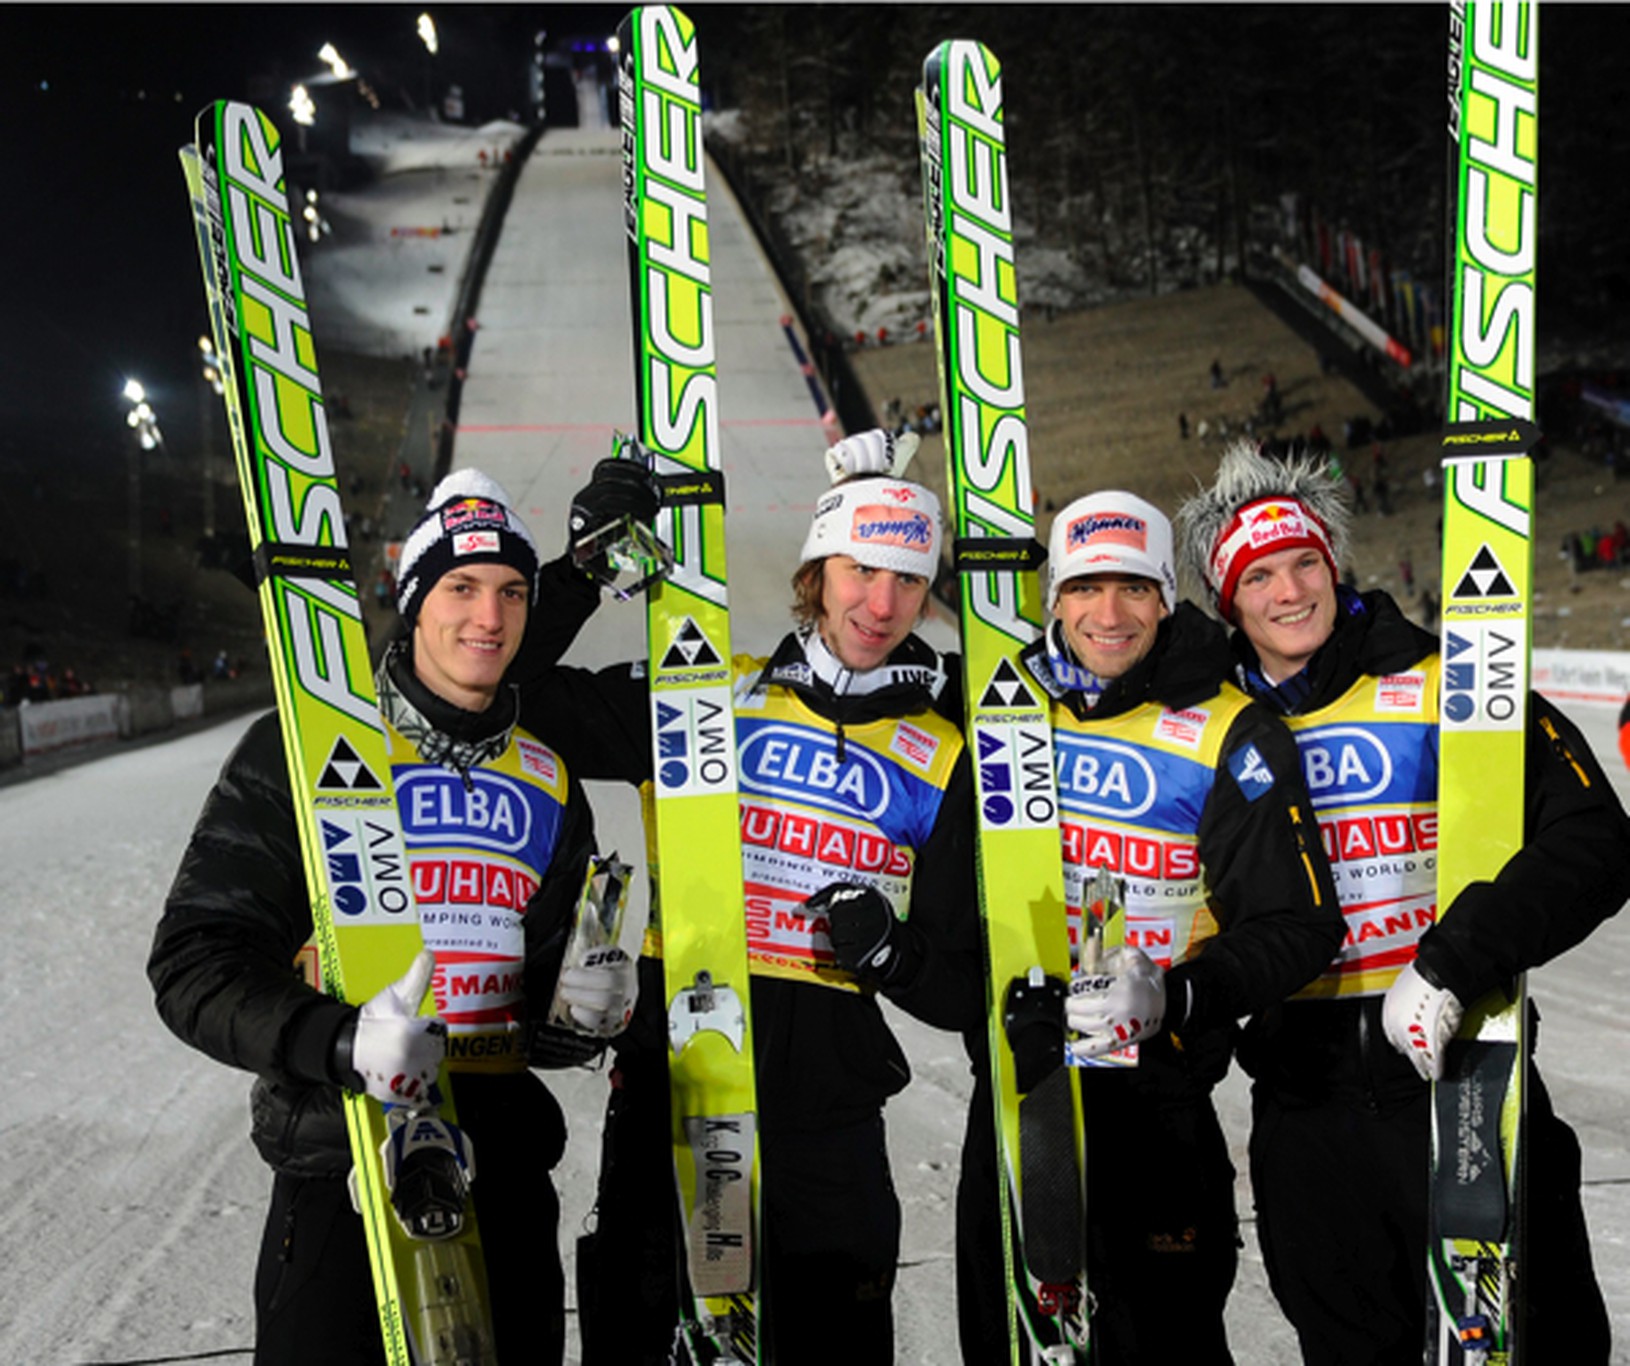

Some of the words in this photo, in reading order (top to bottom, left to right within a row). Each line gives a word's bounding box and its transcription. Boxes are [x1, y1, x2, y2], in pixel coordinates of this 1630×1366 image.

[1454, 3, 1537, 540] FISCHE
[639, 5, 729, 606] FISCHER
[947, 40, 1045, 643] FISCHER
[223, 101, 387, 735] FISCHER
[1251, 524, 1280, 544] Red
[1280, 521, 1304, 536] Bull
[1445, 602, 1523, 614] FISCHER
[654, 671, 728, 685] FISCHER
[1485, 630, 1516, 722] OMV
[696, 699, 728, 785] OMV
[974, 712, 1045, 723] FISCHER
[756, 740, 867, 806] ELBA
[1019, 730, 1054, 823] OMV
[1057, 751, 1132, 804] LBA
[1305, 743, 1372, 789] BA
[313, 796, 392, 807] FISCHER
[411, 784, 516, 837] ELBA
[364, 821, 409, 914] OMV
[746, 811, 909, 873] UHAUS
[1062, 830, 1196, 875] HAUS
[414, 865, 537, 908] UHAU
[1348, 860, 1417, 880] WORLD
[423, 911, 483, 927] MPING
[1346, 903, 1437, 946] ANN
